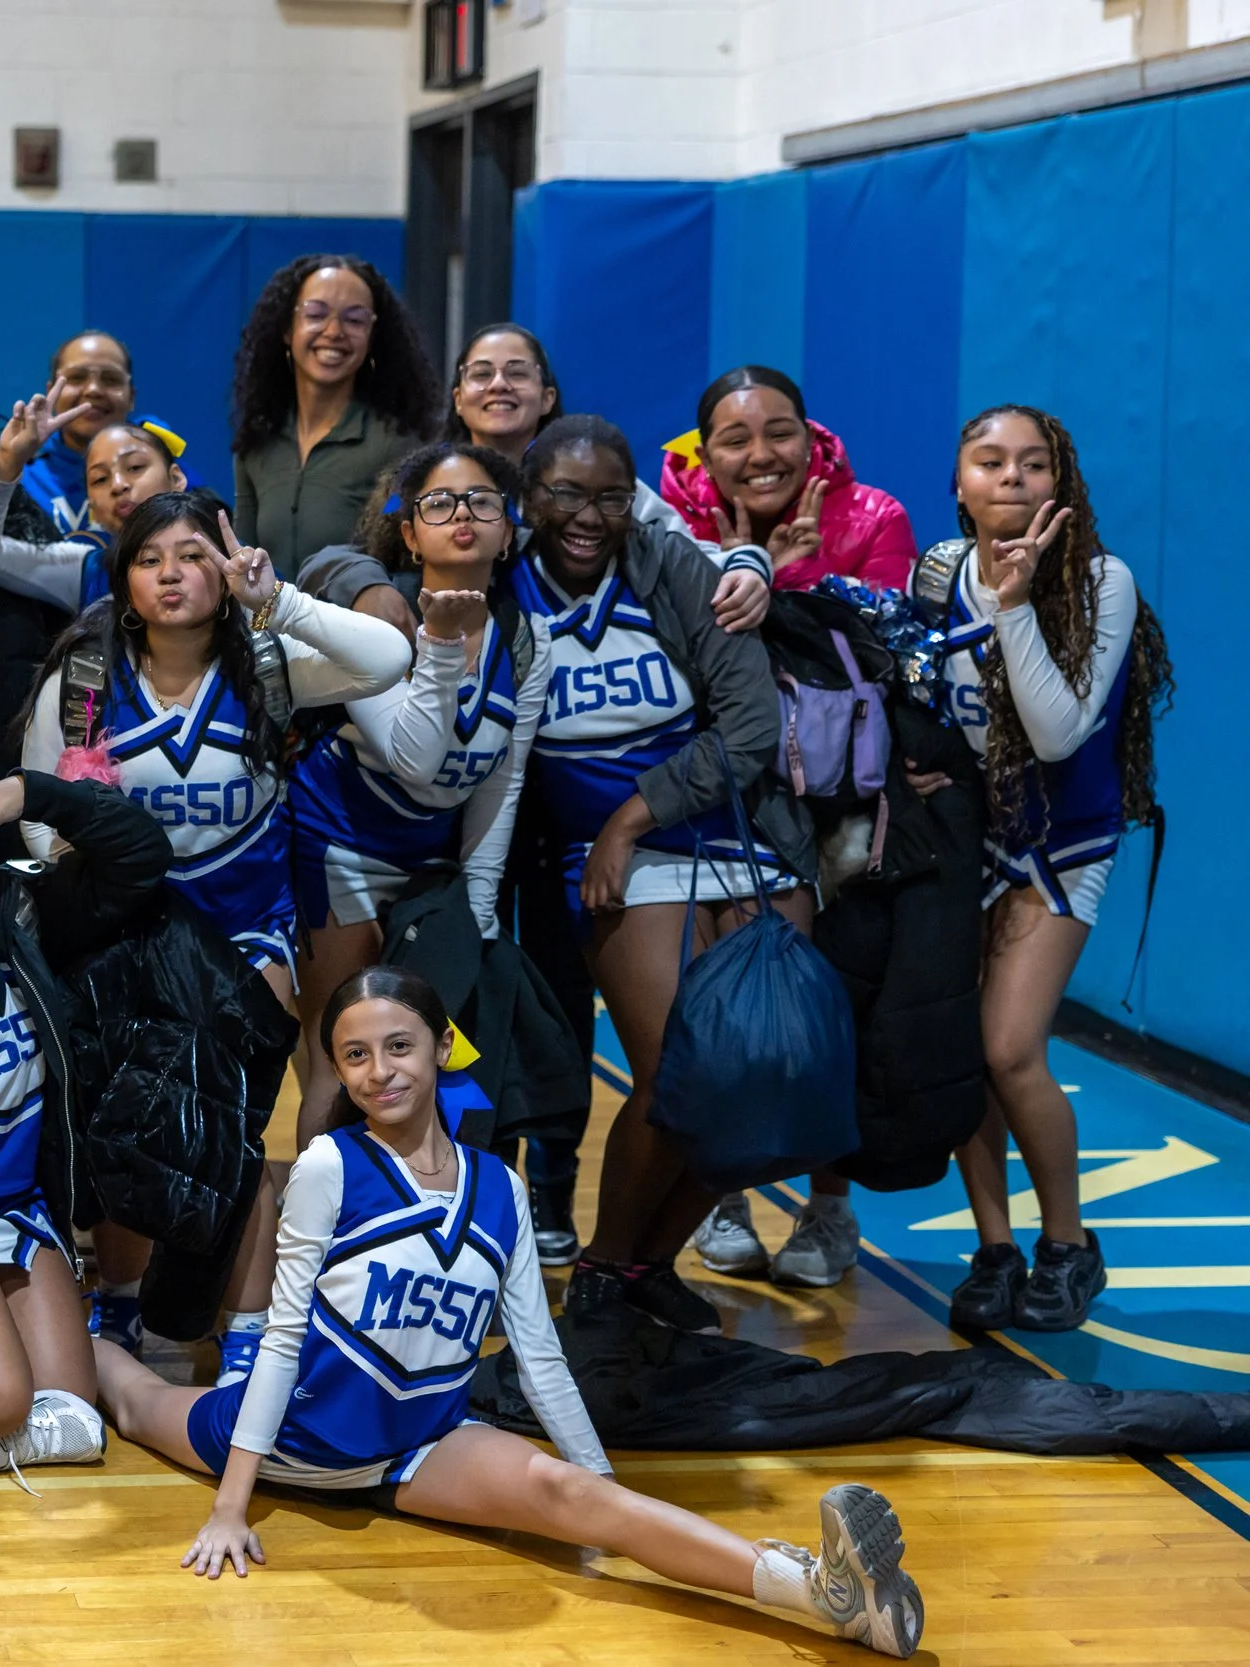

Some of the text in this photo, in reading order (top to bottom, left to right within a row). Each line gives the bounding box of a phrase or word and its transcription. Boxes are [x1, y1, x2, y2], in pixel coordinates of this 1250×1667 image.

[538, 651, 678, 728] MS50
[432, 746, 508, 790] S50
[353, 1261, 496, 1354] MS50
